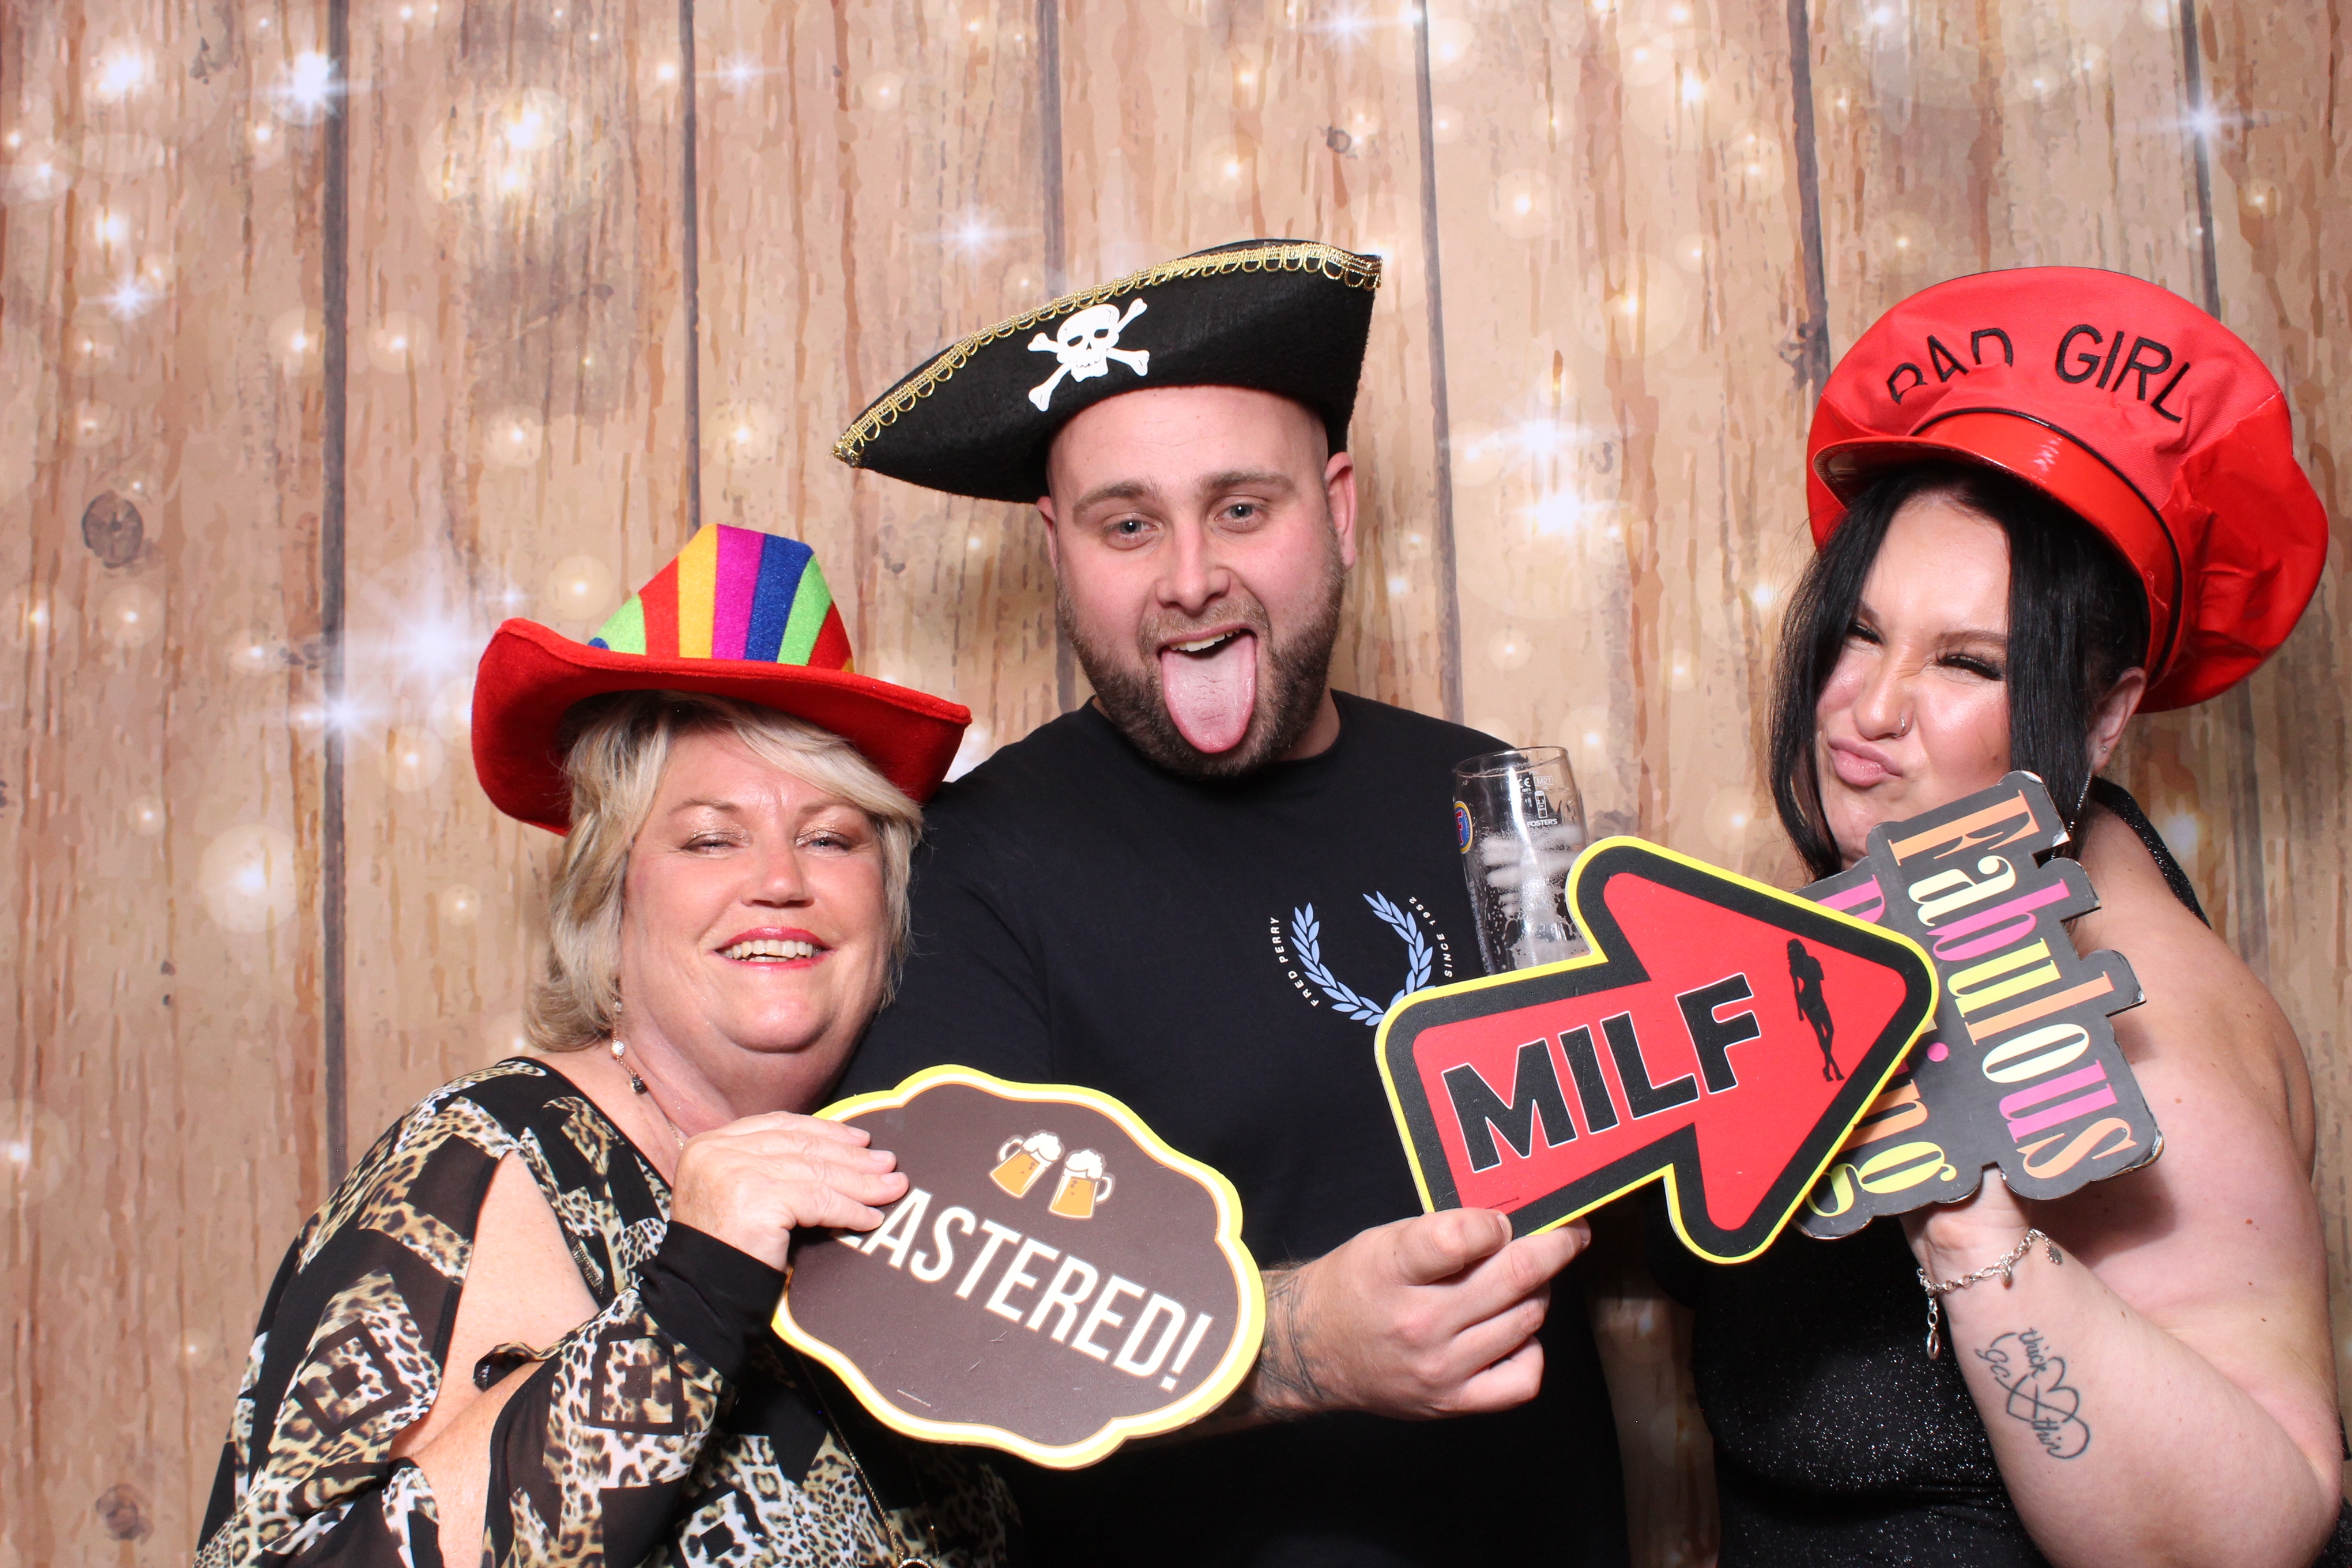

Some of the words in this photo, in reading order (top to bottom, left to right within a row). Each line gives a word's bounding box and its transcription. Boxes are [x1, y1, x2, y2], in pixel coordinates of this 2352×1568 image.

[2054, 323, 2191, 423] GIRL
[1270, 917, 1289, 964] PERRY
[1409, 896, 1436, 926] 1952
[1288, 970, 1320, 1007] FRED
[1437, 932, 1453, 978] SINCE
[1887, 789, 2137, 1179] Fabulous
[1441, 972, 1761, 1174] MILF
[830, 1187, 1213, 1392] ASTERED!
